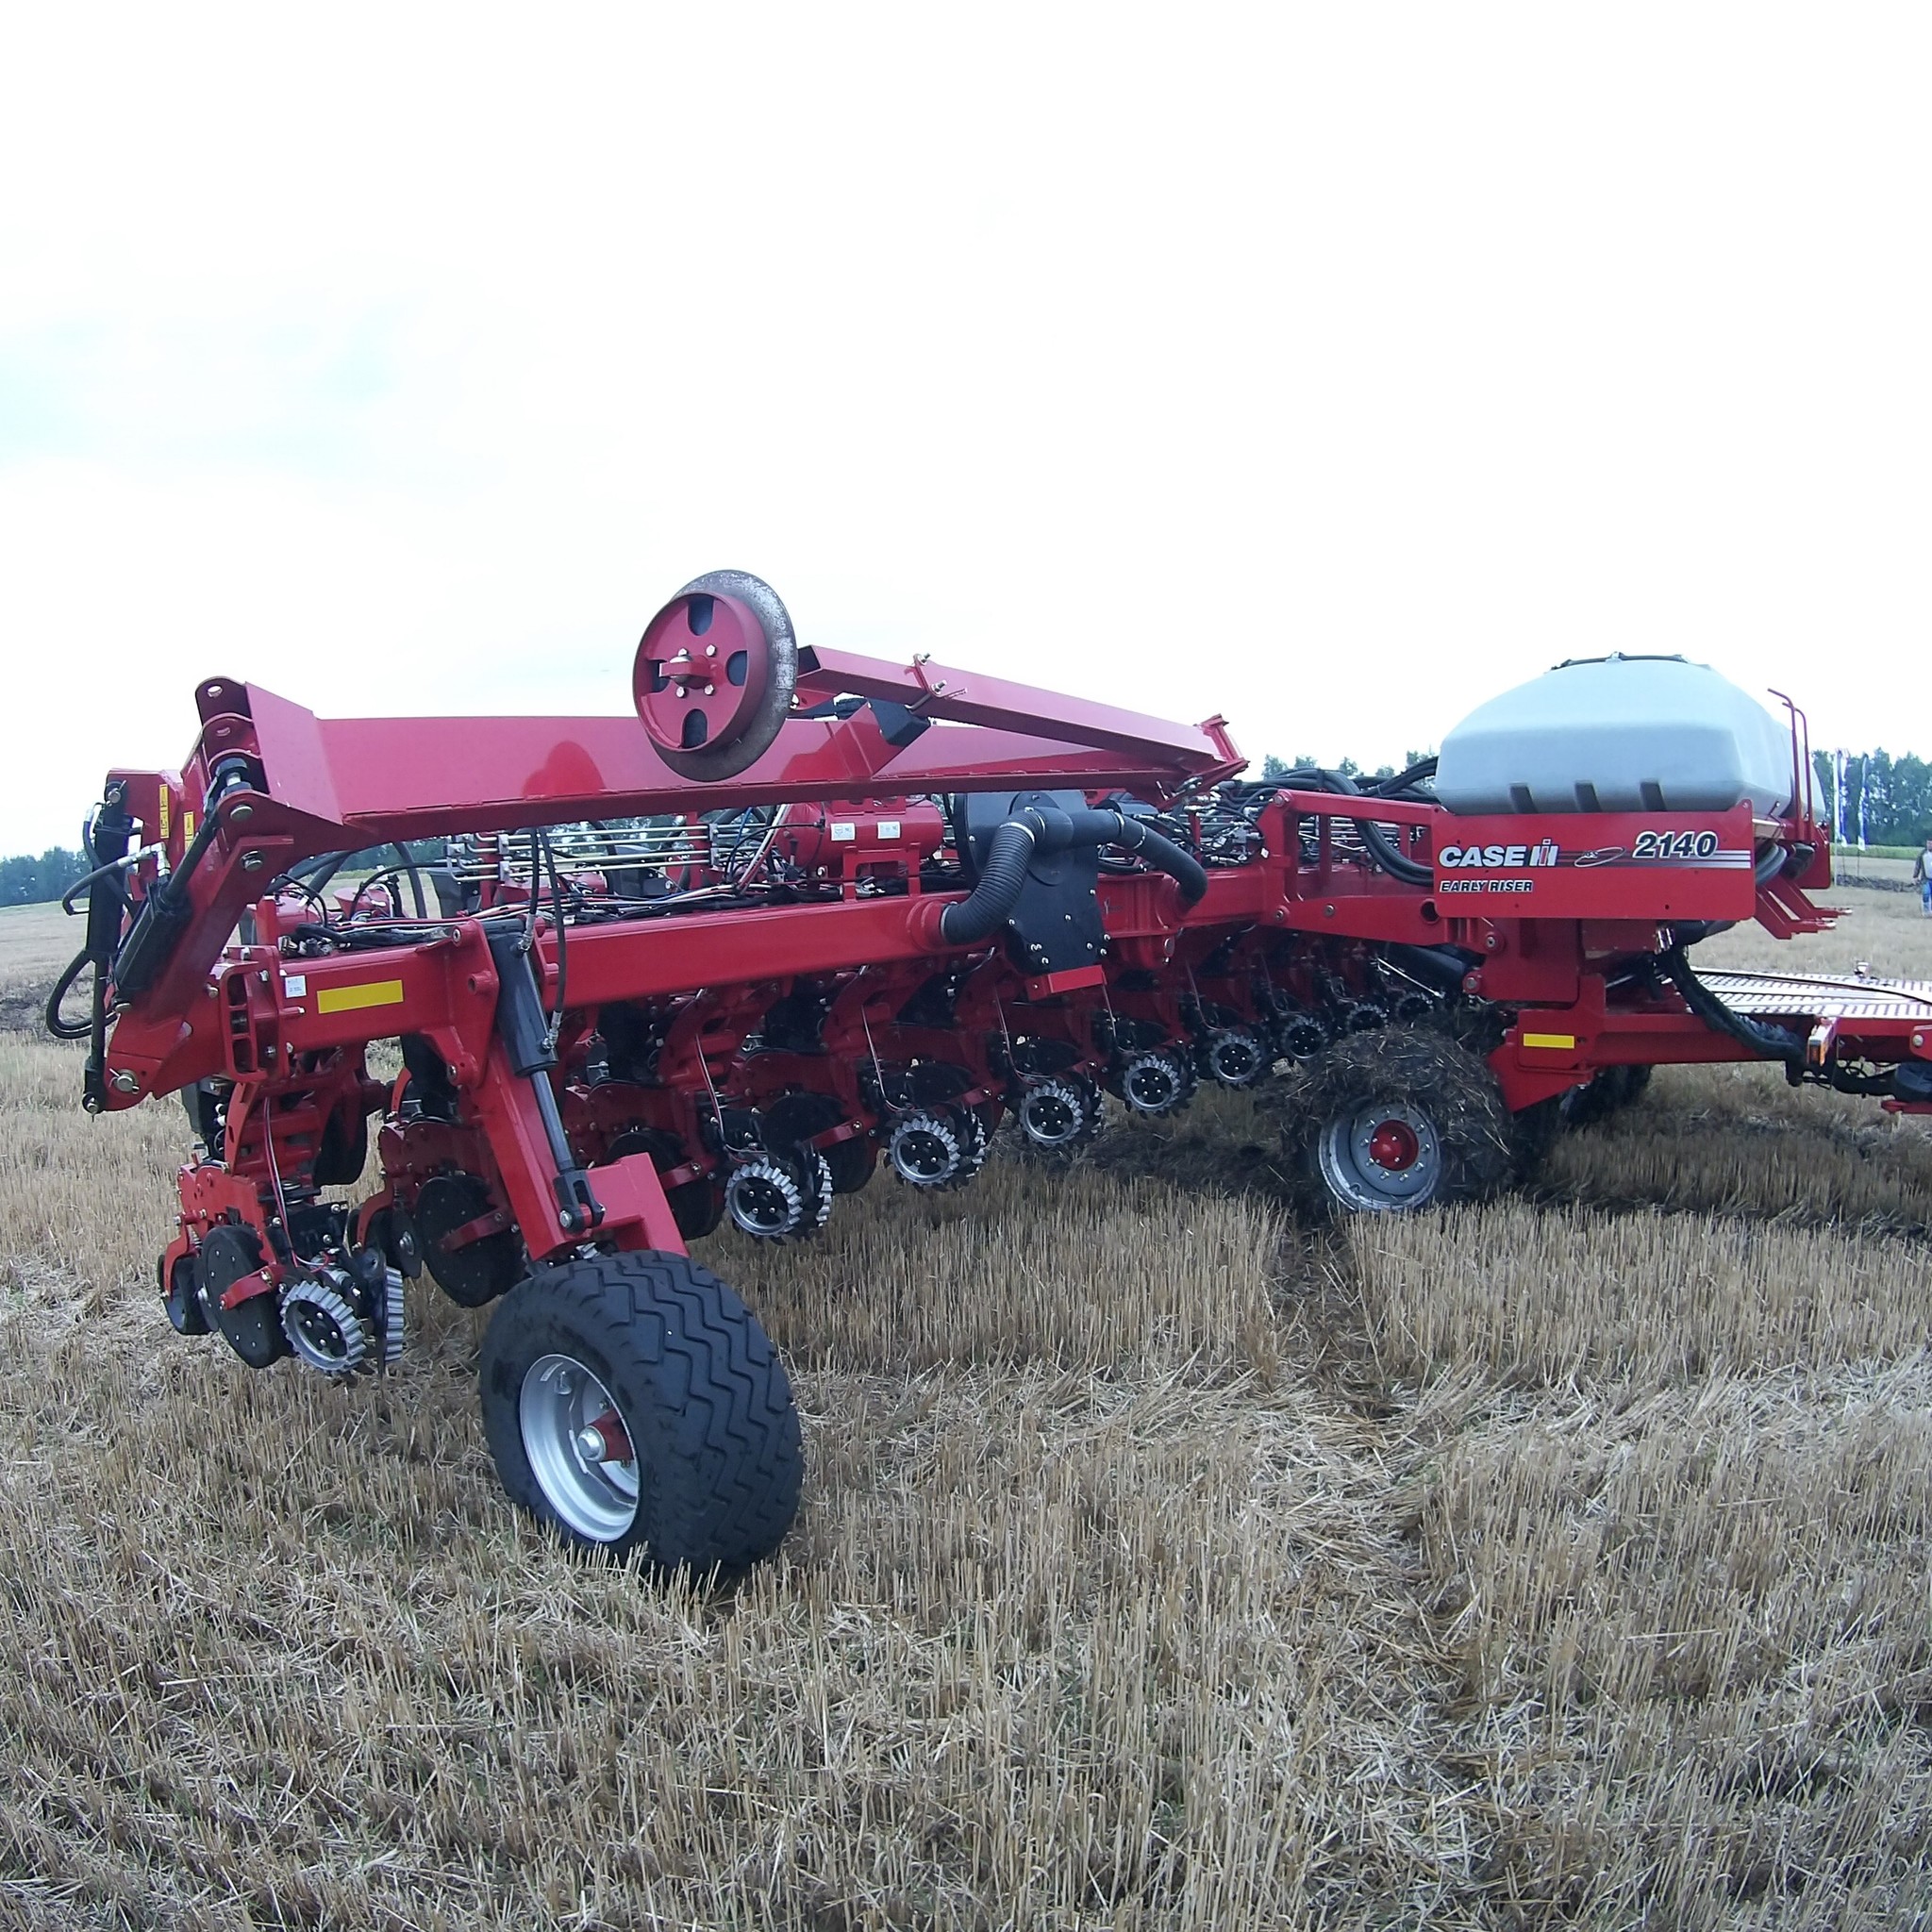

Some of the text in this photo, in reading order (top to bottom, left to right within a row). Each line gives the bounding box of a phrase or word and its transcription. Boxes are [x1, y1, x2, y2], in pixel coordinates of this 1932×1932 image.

[1439, 845, 1527, 868] CASE
[1632, 831, 1719, 859] 2140
[1440, 880, 1533, 892] EARLY RISER
